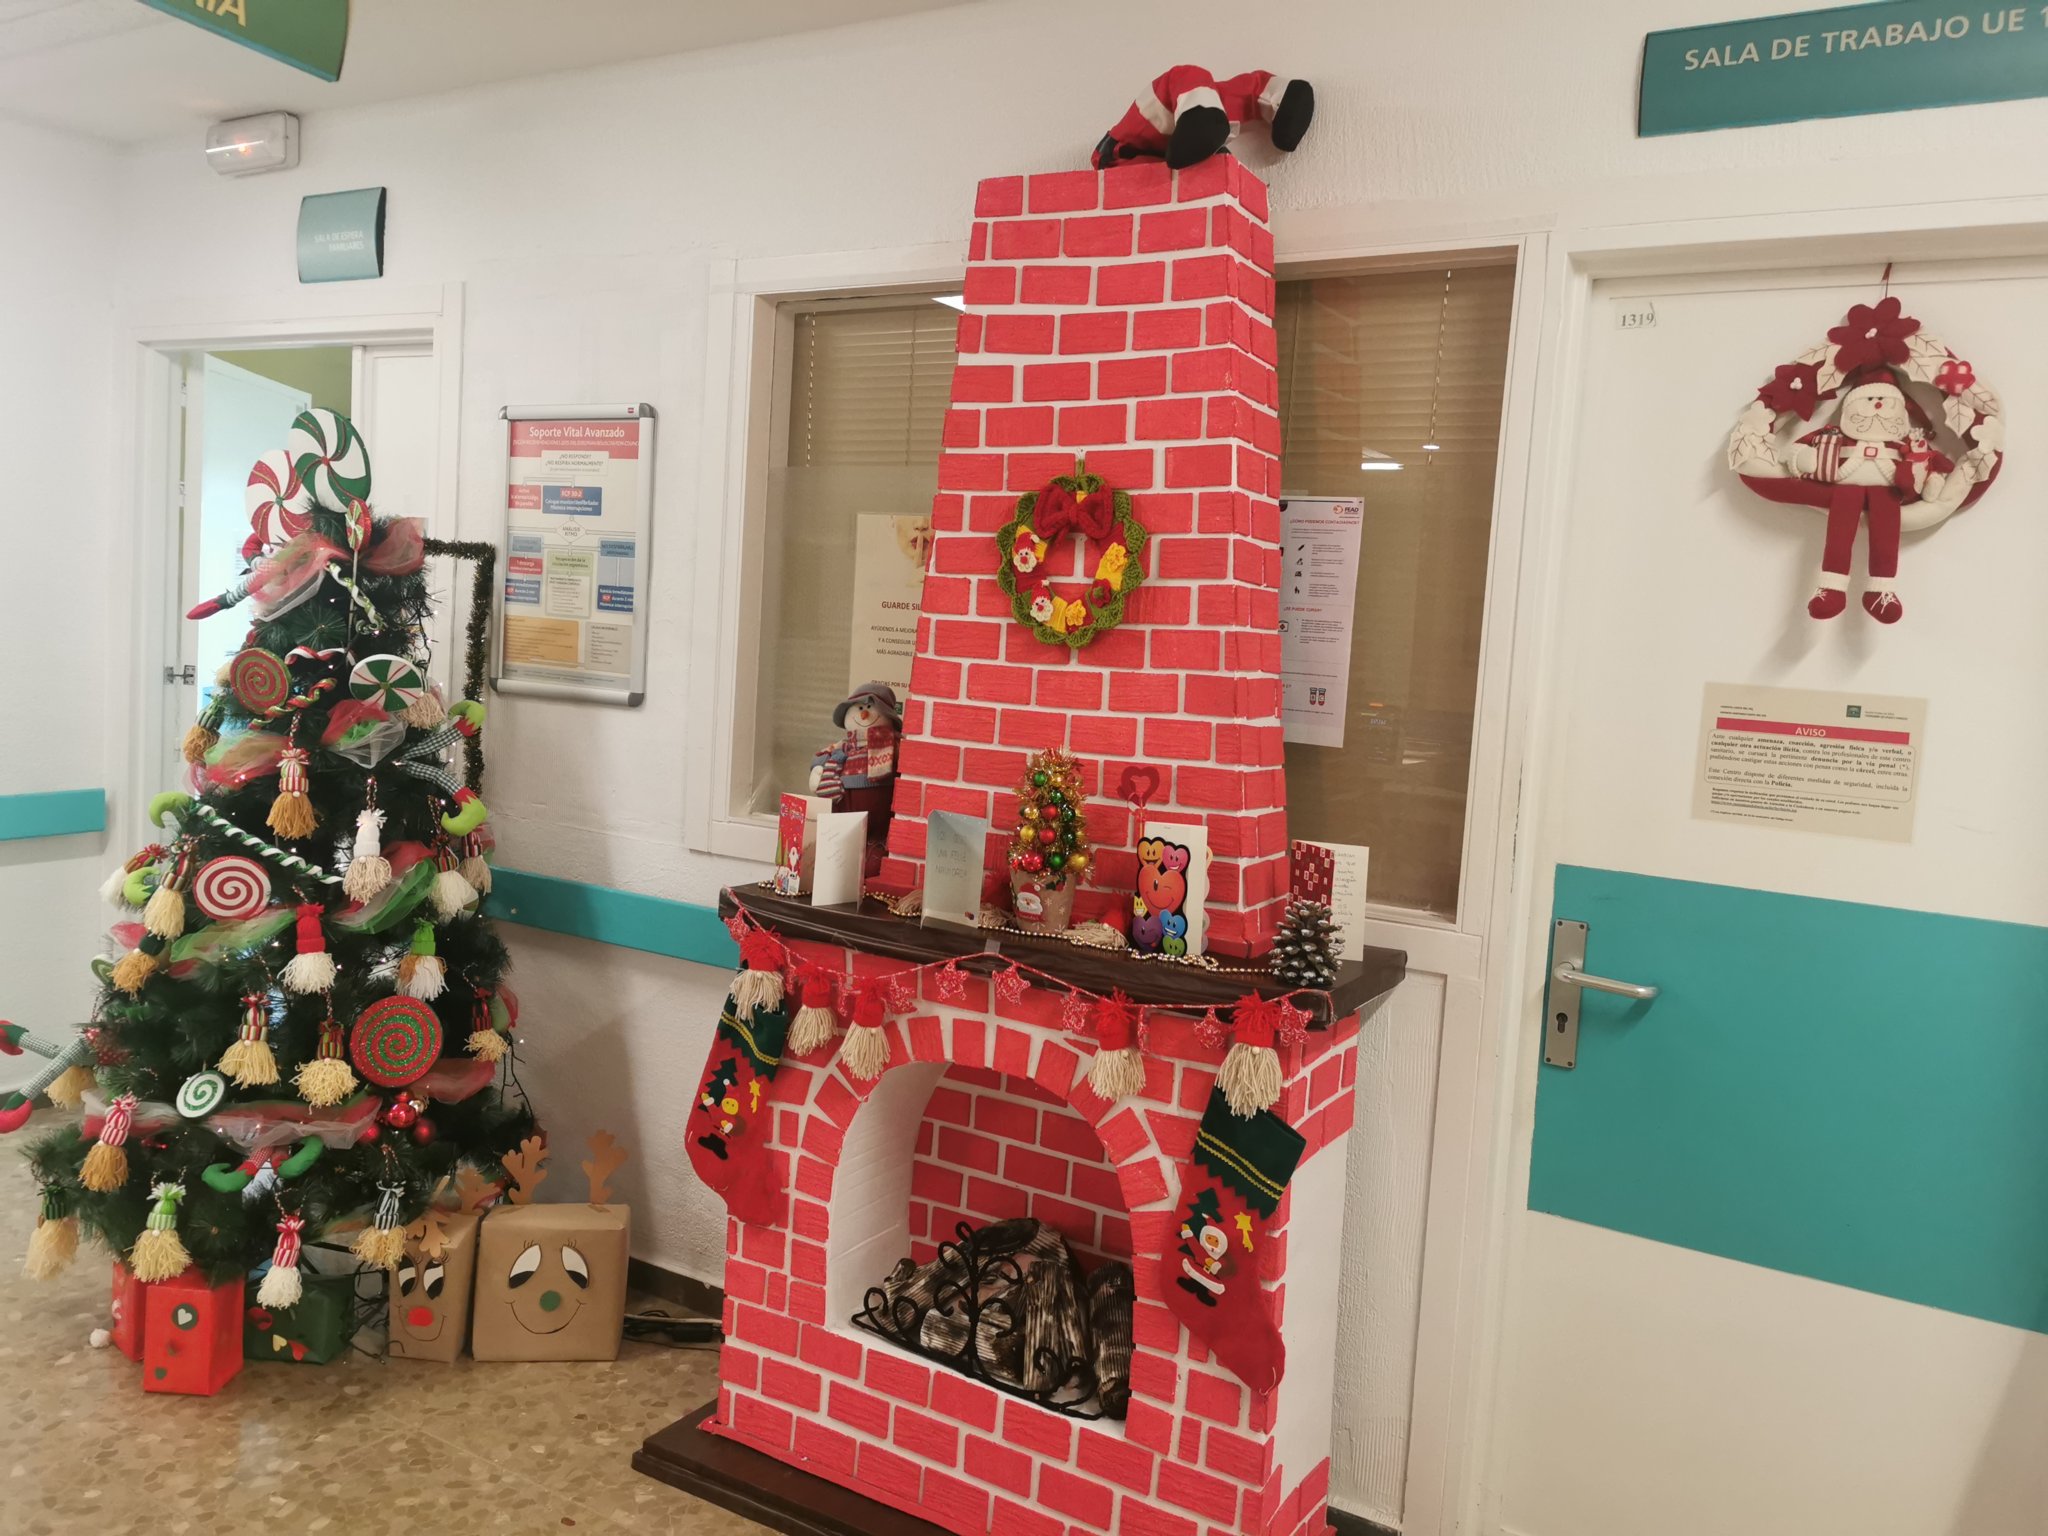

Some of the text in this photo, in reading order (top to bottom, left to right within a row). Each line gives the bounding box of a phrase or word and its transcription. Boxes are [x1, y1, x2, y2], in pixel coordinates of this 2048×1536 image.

[1685, 46, 1759, 70] SALA
[1771, 35, 1809, 60] DE
[1822, 15, 1970, 53] TRABAJO
[1982, 8, 2025, 35] UE
[1622, 313, 1654, 326] 1319
[529, 427, 624, 439] Soporte Vital Avanzado
[882, 601, 910, 610] GUARDE
[1795, 727, 1826, 737] AVISO
[1710, 740, 1737, 748] cualquier
